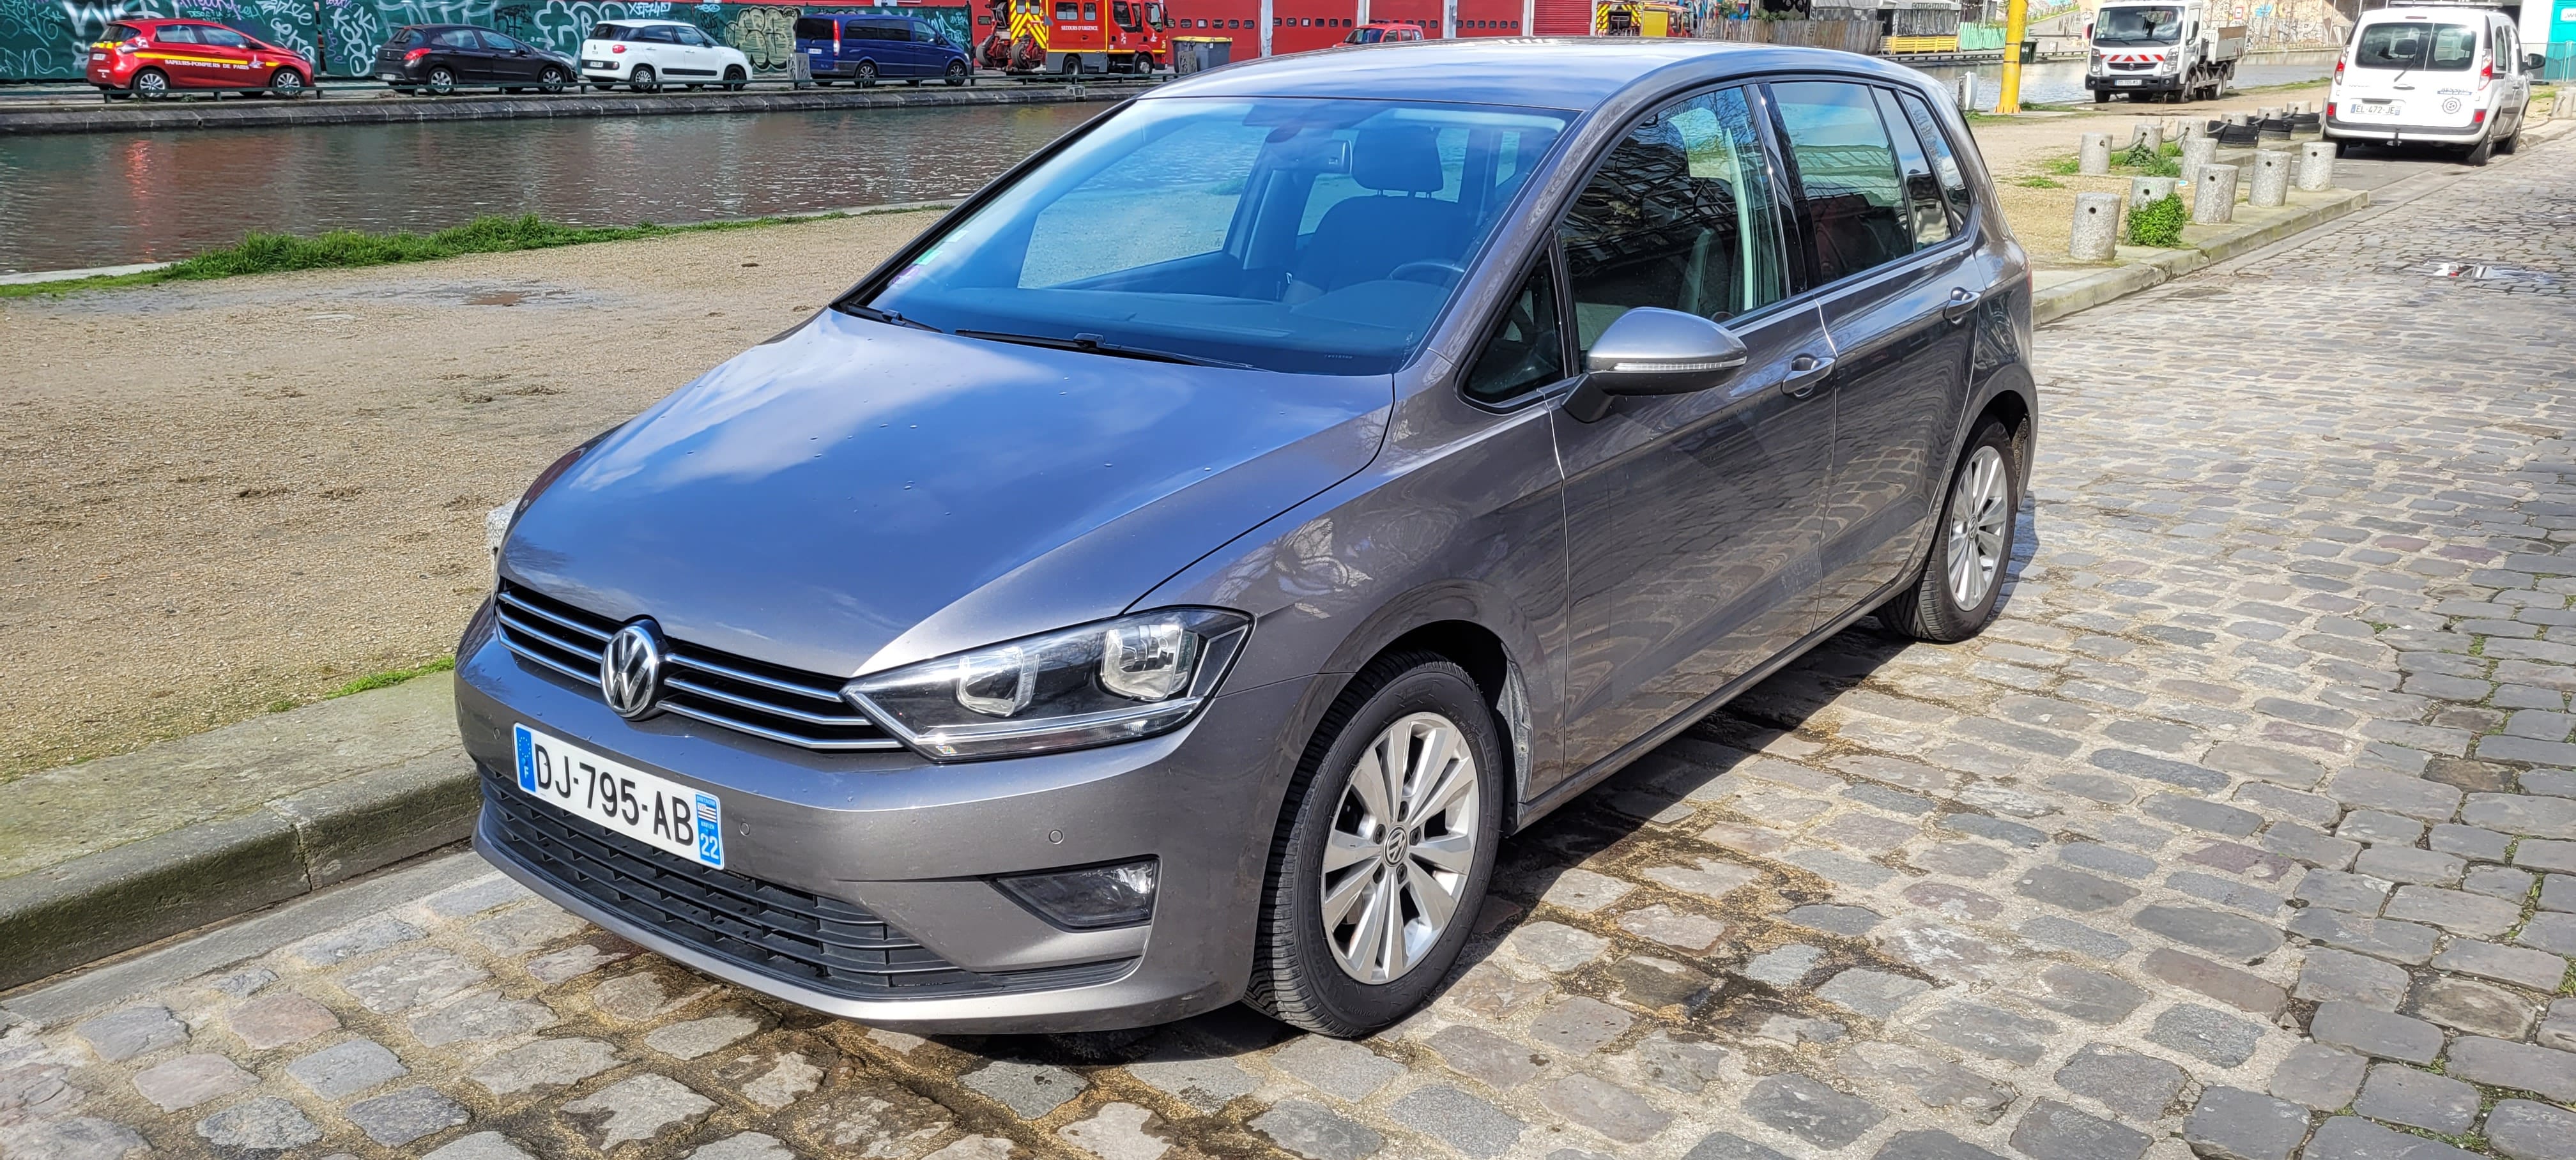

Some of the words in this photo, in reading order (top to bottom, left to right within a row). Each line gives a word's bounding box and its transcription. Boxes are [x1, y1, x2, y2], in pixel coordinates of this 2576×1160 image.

[165, 59, 220, 68] SAPEURS-POMPIERS
[535, 744, 694, 846] DJ-795-AB
[700, 832, 720, 859] 22
